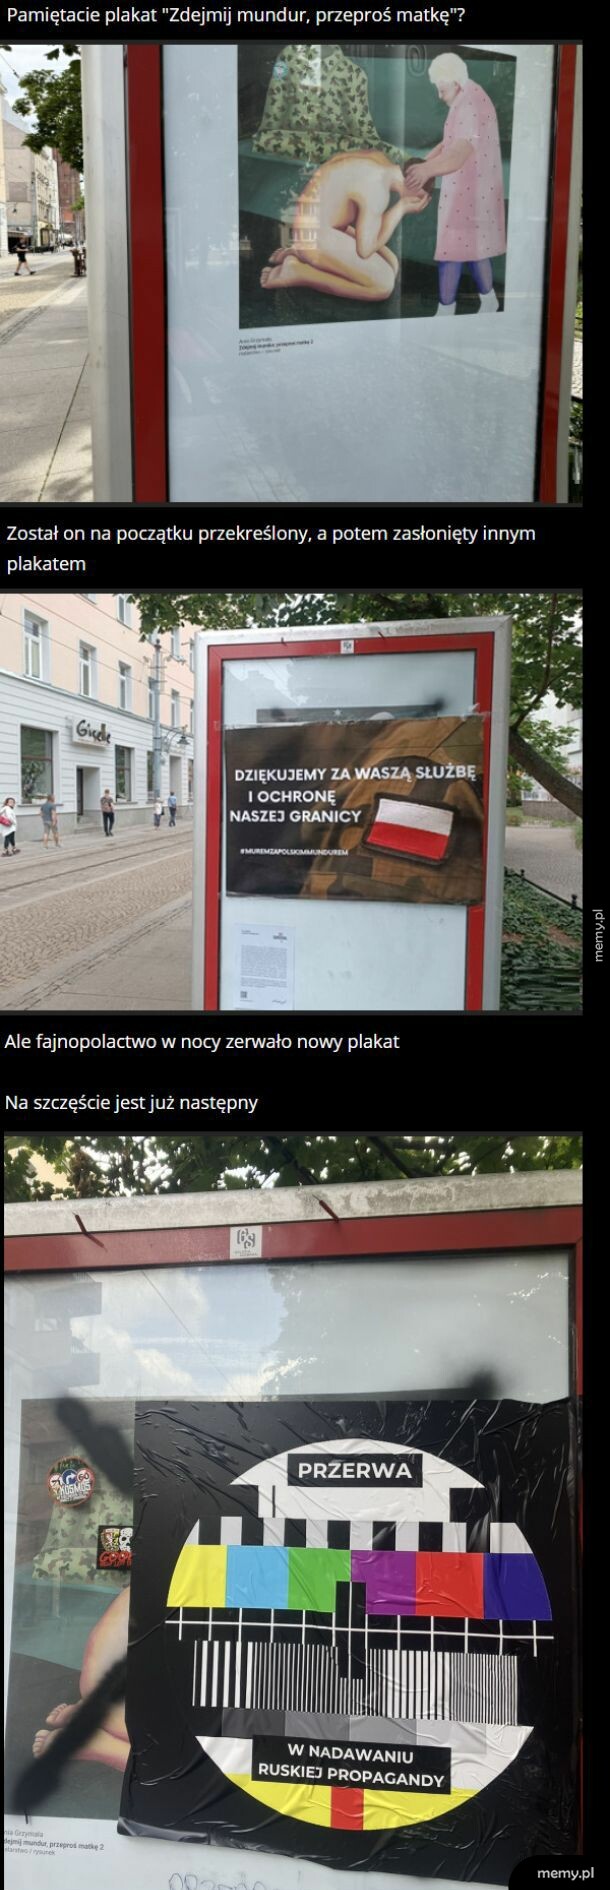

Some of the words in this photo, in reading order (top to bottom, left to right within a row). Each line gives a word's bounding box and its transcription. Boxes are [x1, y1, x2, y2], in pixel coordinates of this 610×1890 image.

[234, 767, 327, 785] DZIĘKUJEMY
[330, 768, 351, 781] ZA
[354, 766, 413, 783] WASZĄ
[415, 762, 477, 782] SŁUŻBĘ
[248, 790, 253, 803] I
[257, 789, 337, 807] OCHRONĘ
[229, 809, 285, 823] NASZEJ
[289, 809, 362, 823] GRANICY
[298, 1462, 413, 1479] PRZERWA
[287, 1743, 305, 1757] W
[309, 1744, 414, 1764] NADAWANIU
[258, 1762, 323, 1779] RUSKIEJ
[327, 1767, 445, 1788] PROPAGANDY
[99, 1843, 105, 1851] 2
